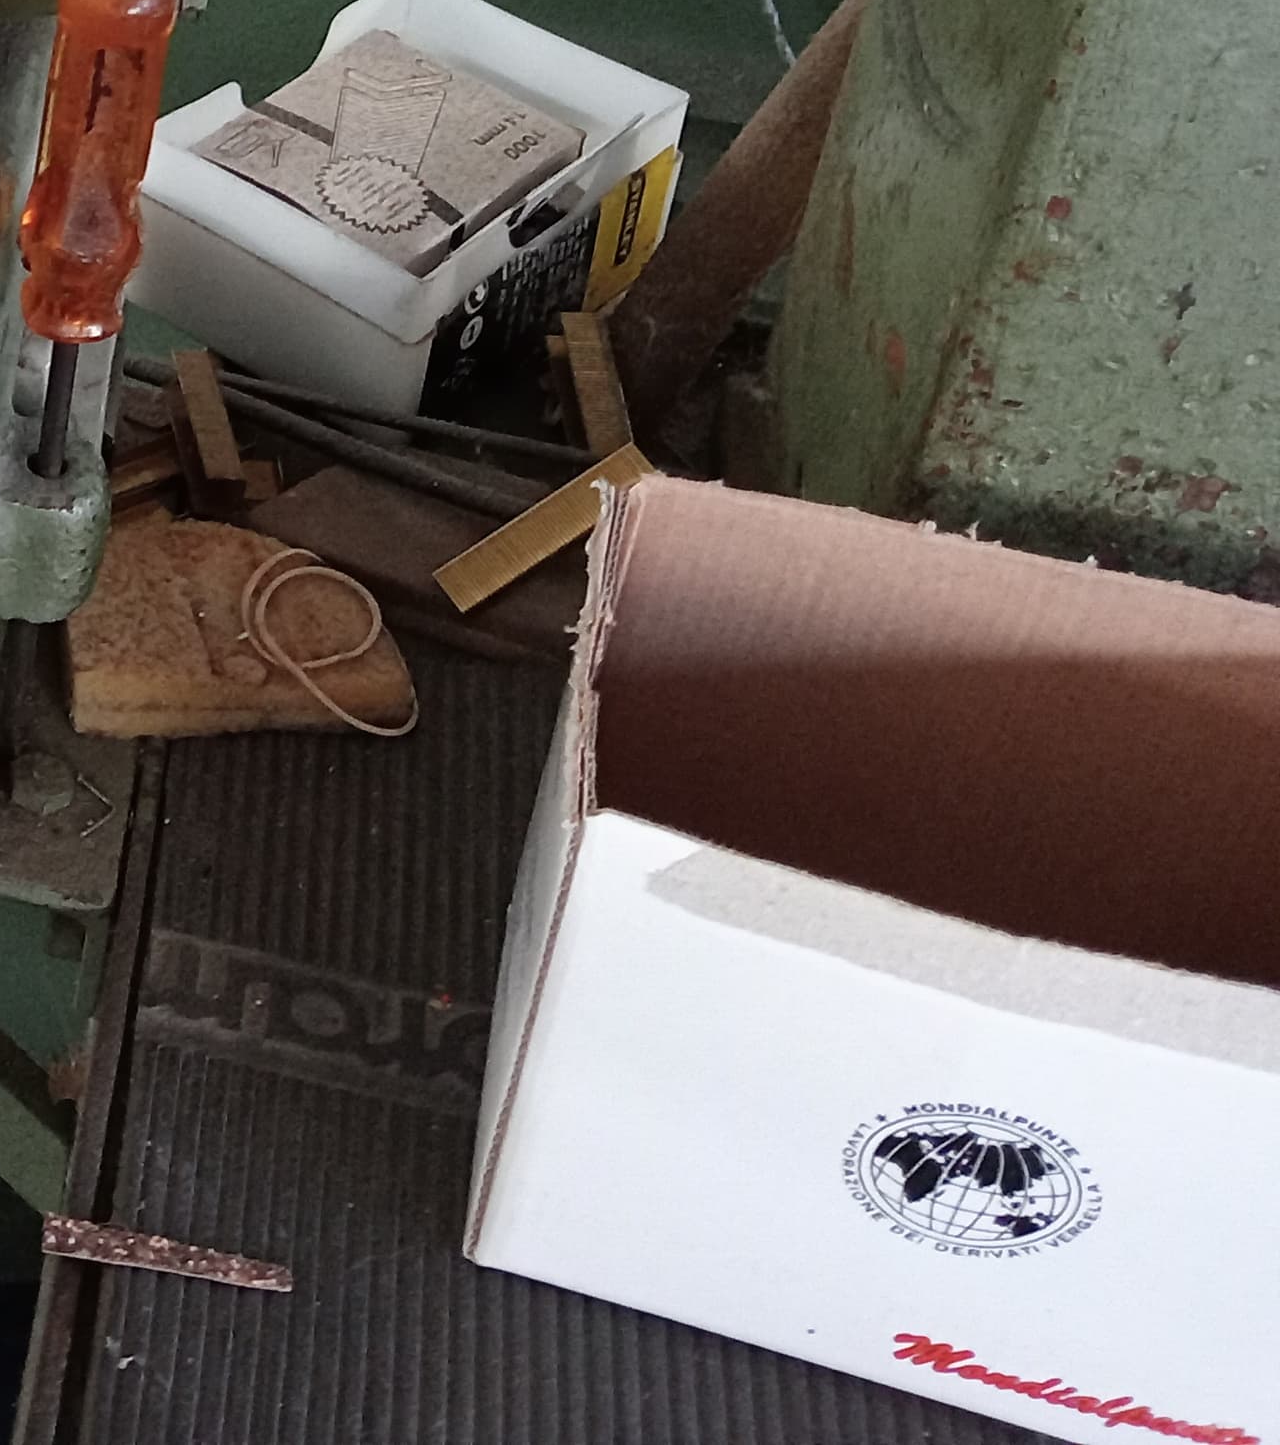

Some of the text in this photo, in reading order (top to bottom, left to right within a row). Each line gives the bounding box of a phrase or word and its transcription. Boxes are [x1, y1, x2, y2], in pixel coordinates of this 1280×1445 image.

[503, 129, 547, 160] 1000
[903, 1102, 1081, 1159] MONDIALPUNTE
[841, 1122, 1104, 1259] LAVORAZIONE DEI DERIVATI VERGELLA
[893, 1332, 1262, 1445] Mondialpunte
